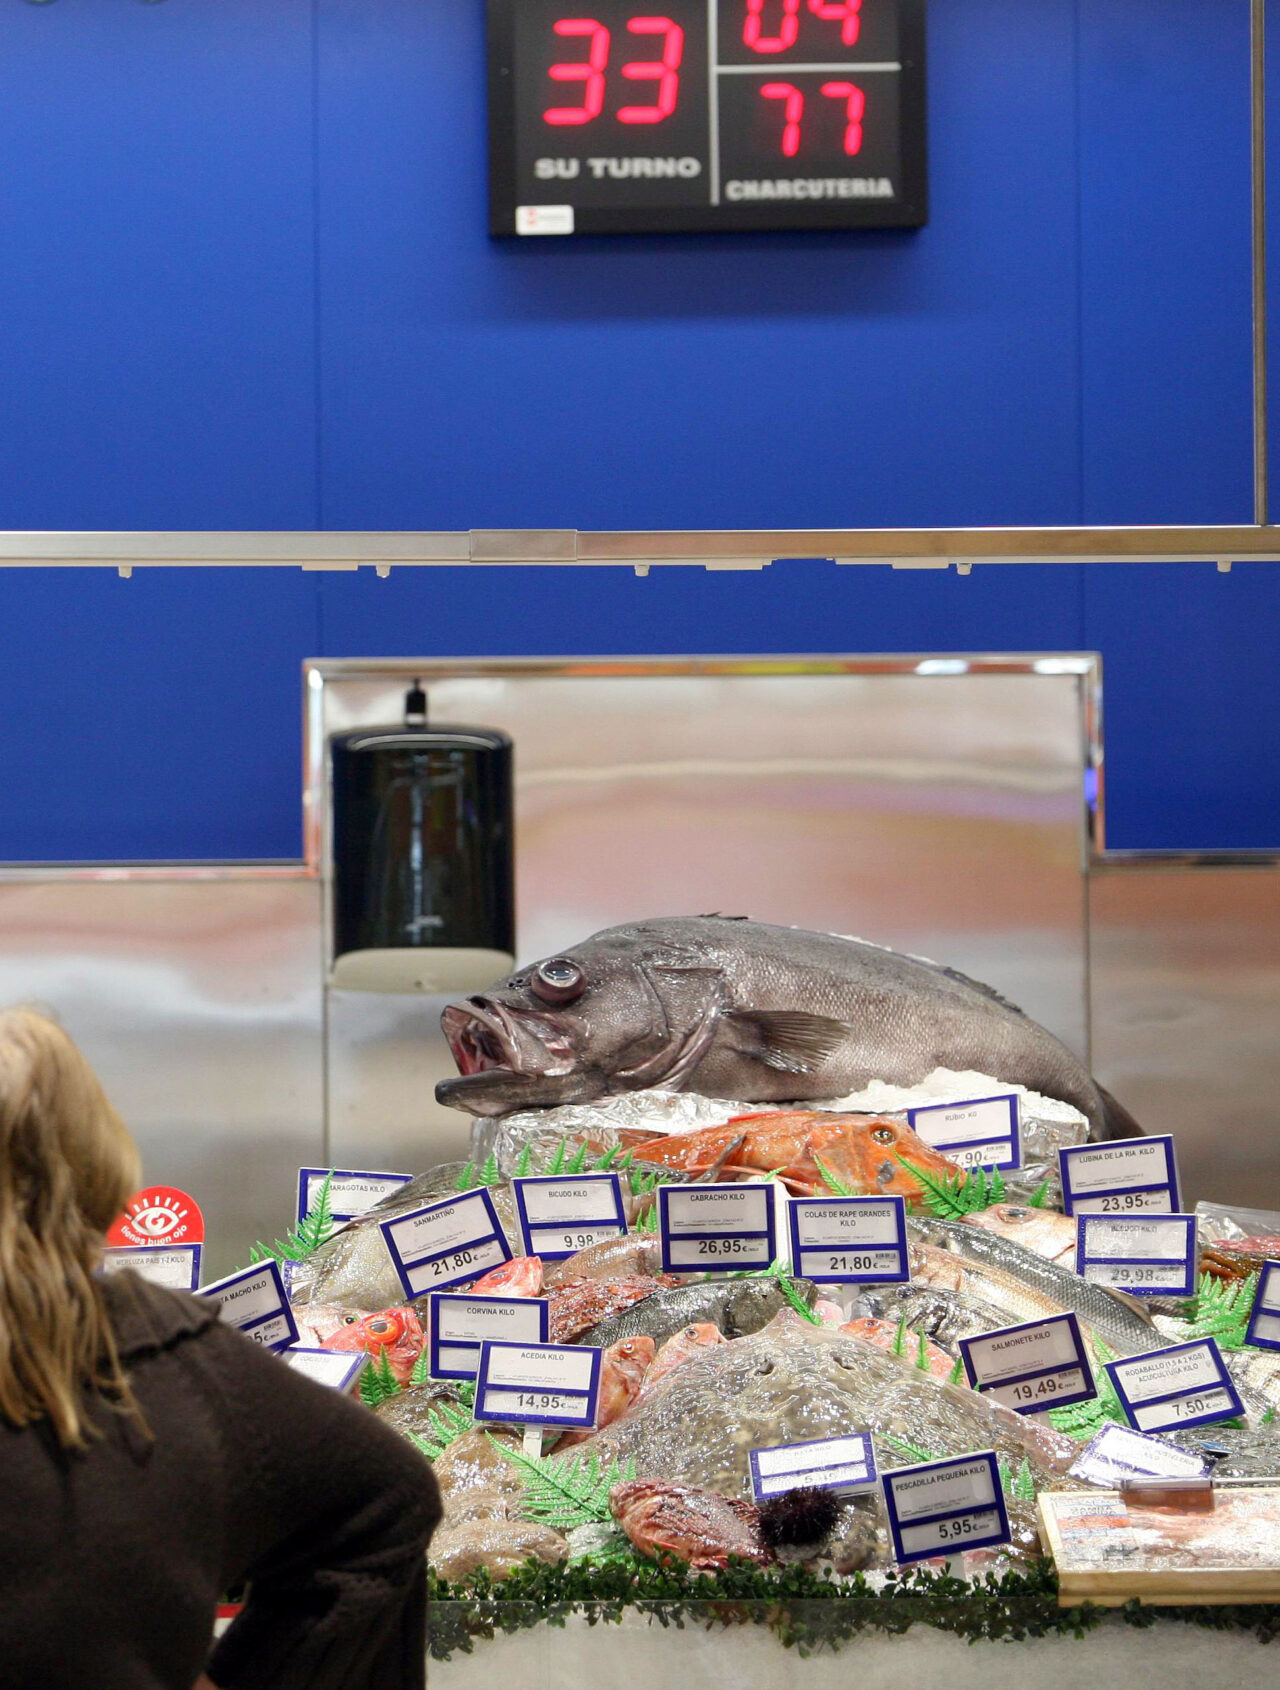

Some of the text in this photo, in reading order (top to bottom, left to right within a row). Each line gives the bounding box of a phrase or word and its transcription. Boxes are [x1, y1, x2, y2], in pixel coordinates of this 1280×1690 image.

[543, 17, 684, 126] 33
[760, 82, 865, 158] 77
[535, 156, 702, 180] SU TURNO
[726, 178, 894, 200] CHARCUTERIA
[1079, 1153, 1103, 1163] LUBINA
[1104, 1152, 1114, 1160] DE
[1115, 1151, 1124, 1159] LA
[1139, 1147, 1155, 1155] KILO
[548, 1190, 588, 1198] BICUDO KILO
[690, 1193, 745, 1202] CABRACHO KILO
[804, 1210, 891, 1219] COLAS DE RAPE GRANDES
[840, 1219, 856, 1227] KILO
[121, 1225, 187, 1245] tienes buen ojo
[229, 1287, 251, 1301] MACHO
[252, 1281, 267, 1291] KILO
[466, 1307, 515, 1316] CORVINA KILO
[991, 1331, 1051, 1352] SALMONETE KILO
[520, 1352, 546, 1360] ACEDIA
[1125, 1363, 1164, 1377] RODABALLO
[895, 1478, 935, 1492] PESCADILLA
[969, 1465, 986, 1474] KILO
